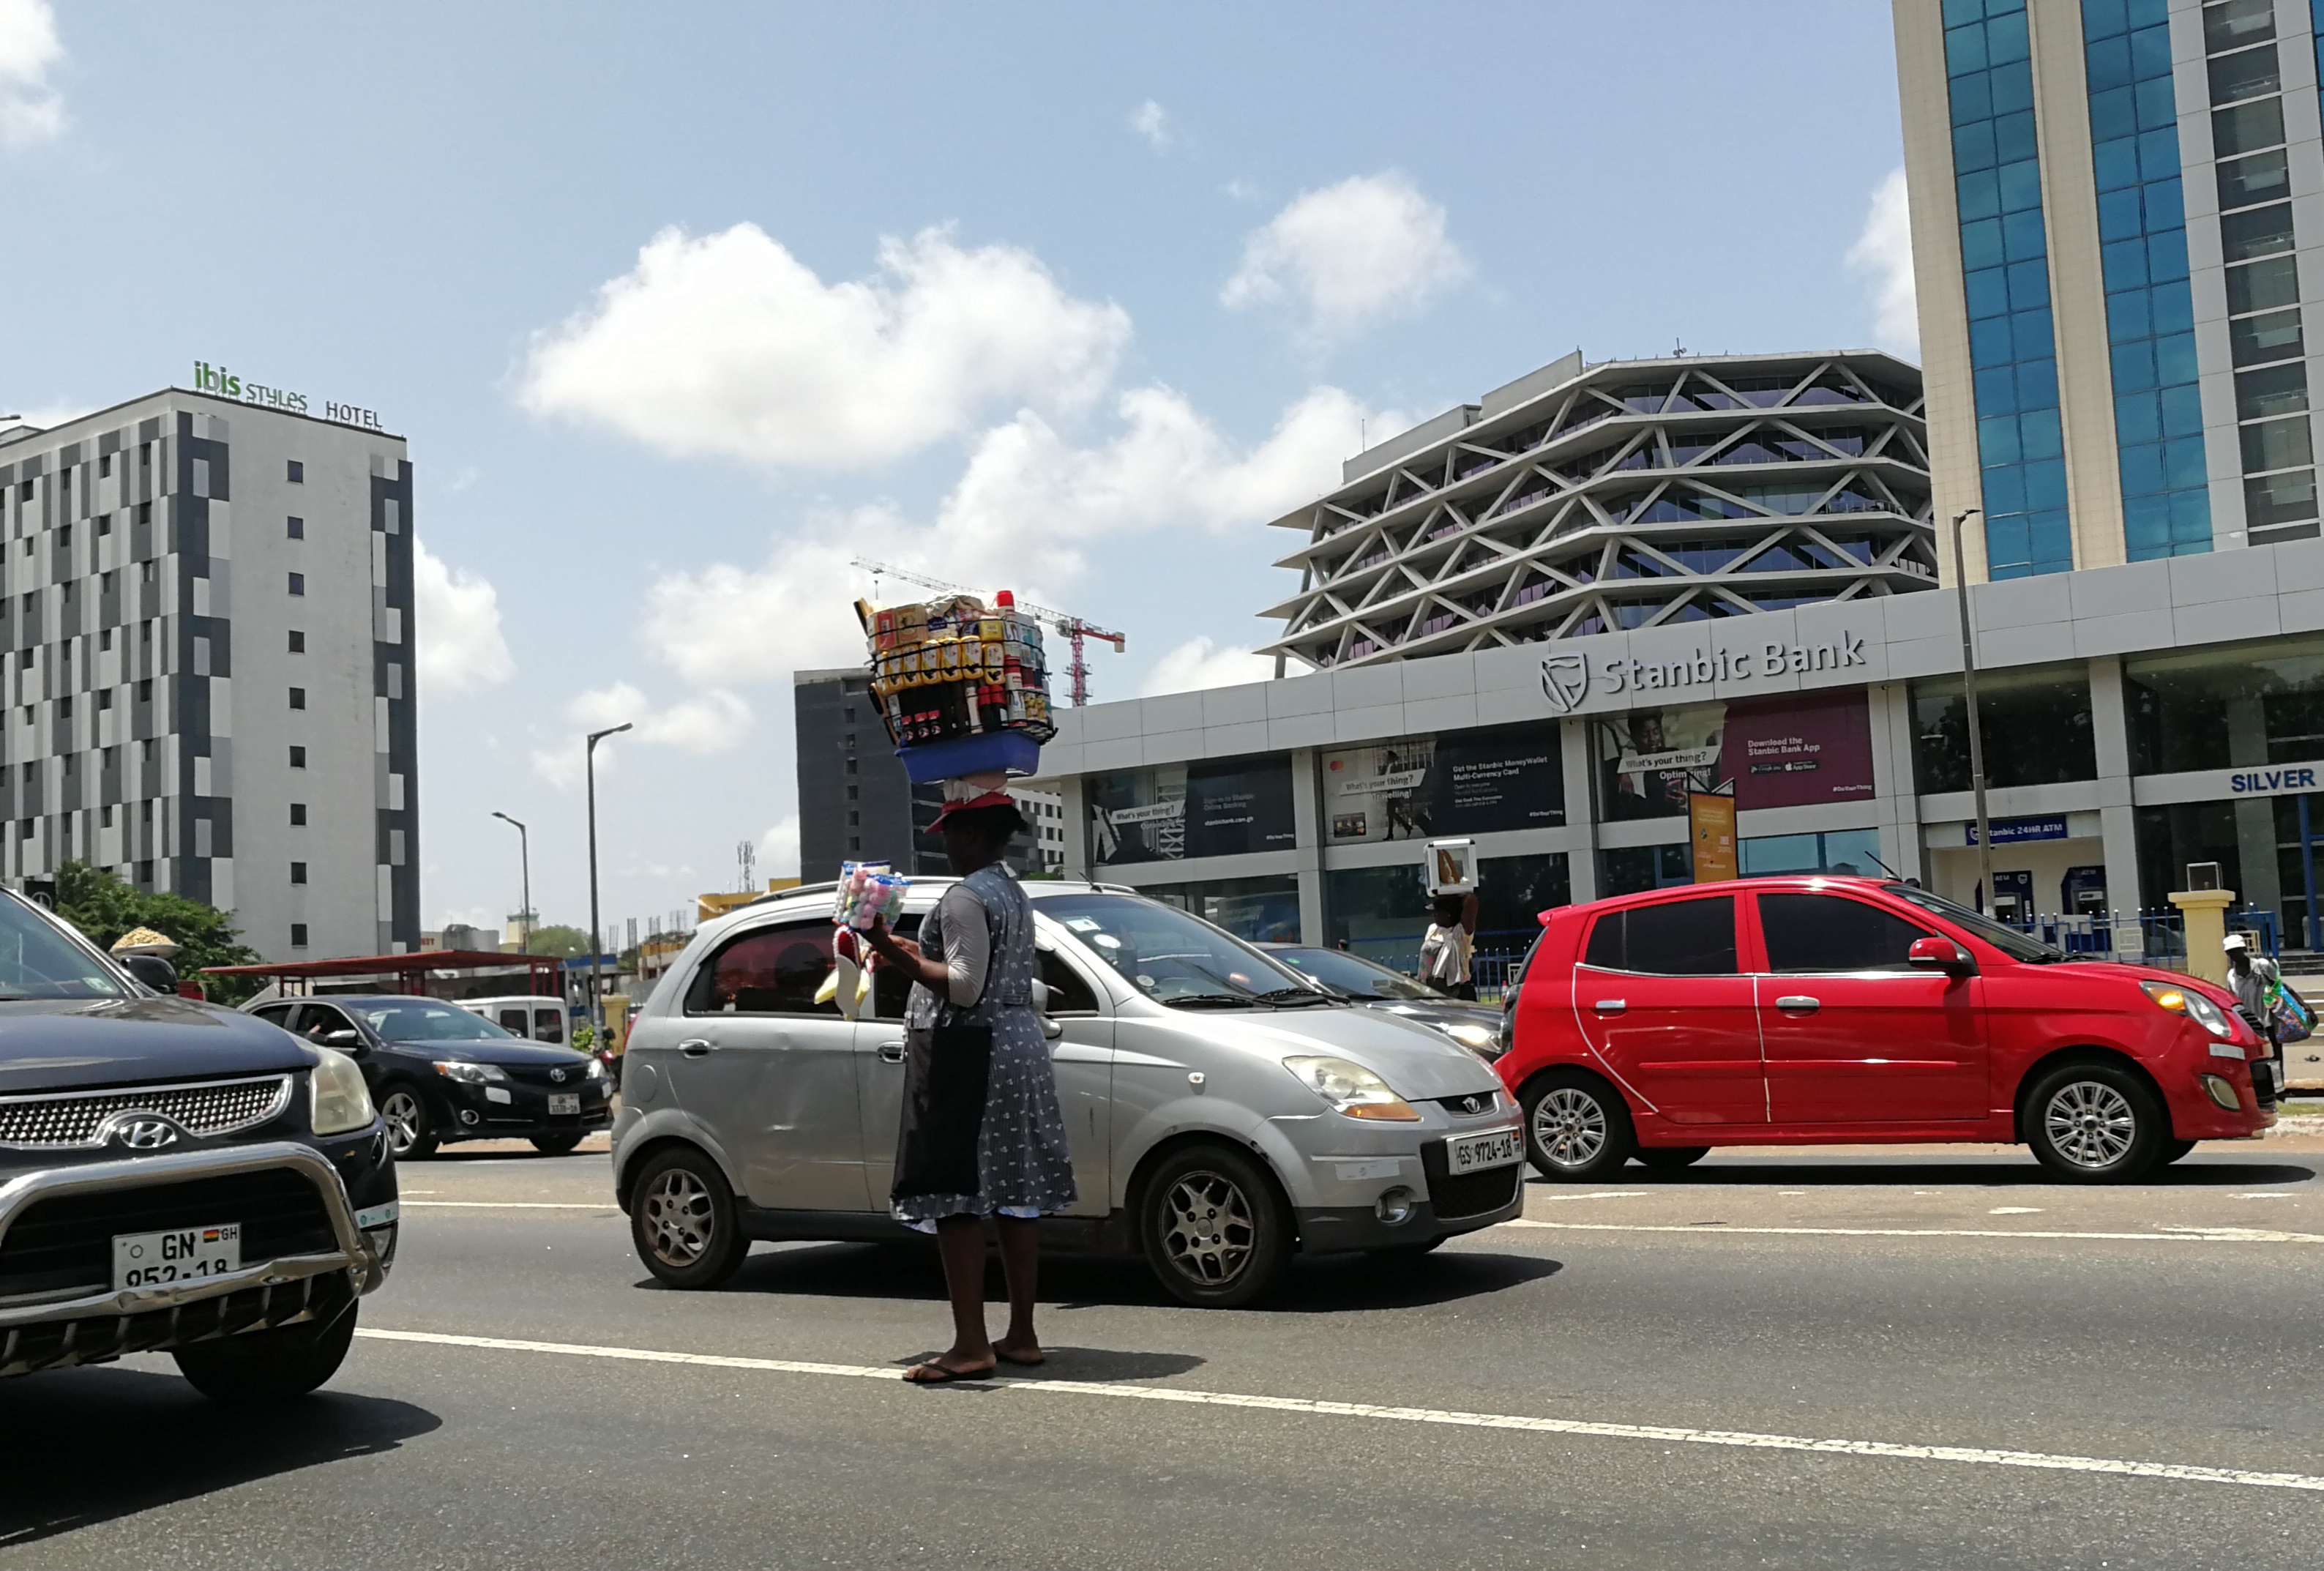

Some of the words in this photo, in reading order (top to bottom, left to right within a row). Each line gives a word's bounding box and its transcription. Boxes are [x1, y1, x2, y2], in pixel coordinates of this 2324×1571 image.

[194, 360, 241, 395] ibis
[326, 401, 382, 428] HOTEL
[1602, 648, 1751, 694] Stanbic
[1762, 630, 1865, 676] Bank
[1747, 737, 1787, 747] Download
[1748, 746, 1779, 756] Stanbic
[1781, 745, 1801, 753] Bank
[1803, 744, 1820, 753] App
[1453, 765, 1465, 773] Get
[1479, 761, 1503, 770] Stanbic
[1505, 756, 1547, 767] MoneyWallet
[1626, 758, 1652, 769] What's
[1654, 756, 1673, 767] your
[1675, 751, 1706, 763] thing?
[1454, 770, 1502, 781] Multi-Currency
[1503, 767, 1520, 776] Card
[2231, 769, 2316, 793] SILVER
[1346, 781, 1367, 791] What's
[1369, 780, 1385, 788] your
[1387, 775, 1413, 786] thing?
[1116, 811, 1135, 820] What's
[1137, 810, 1150, 819] your
[1152, 805, 1174, 816] thing?
[1989, 827, 2016, 836] tanbic
[2017, 825, 2041, 835] 24HR
[2043, 824, 2063, 832] ATM
[1459, 1145, 1471, 1165] GS
[1475, 1138, 1512, 1163] 9724-18
[162, 1232, 195, 1261] GN
[221, 1226, 237, 1240] GH
